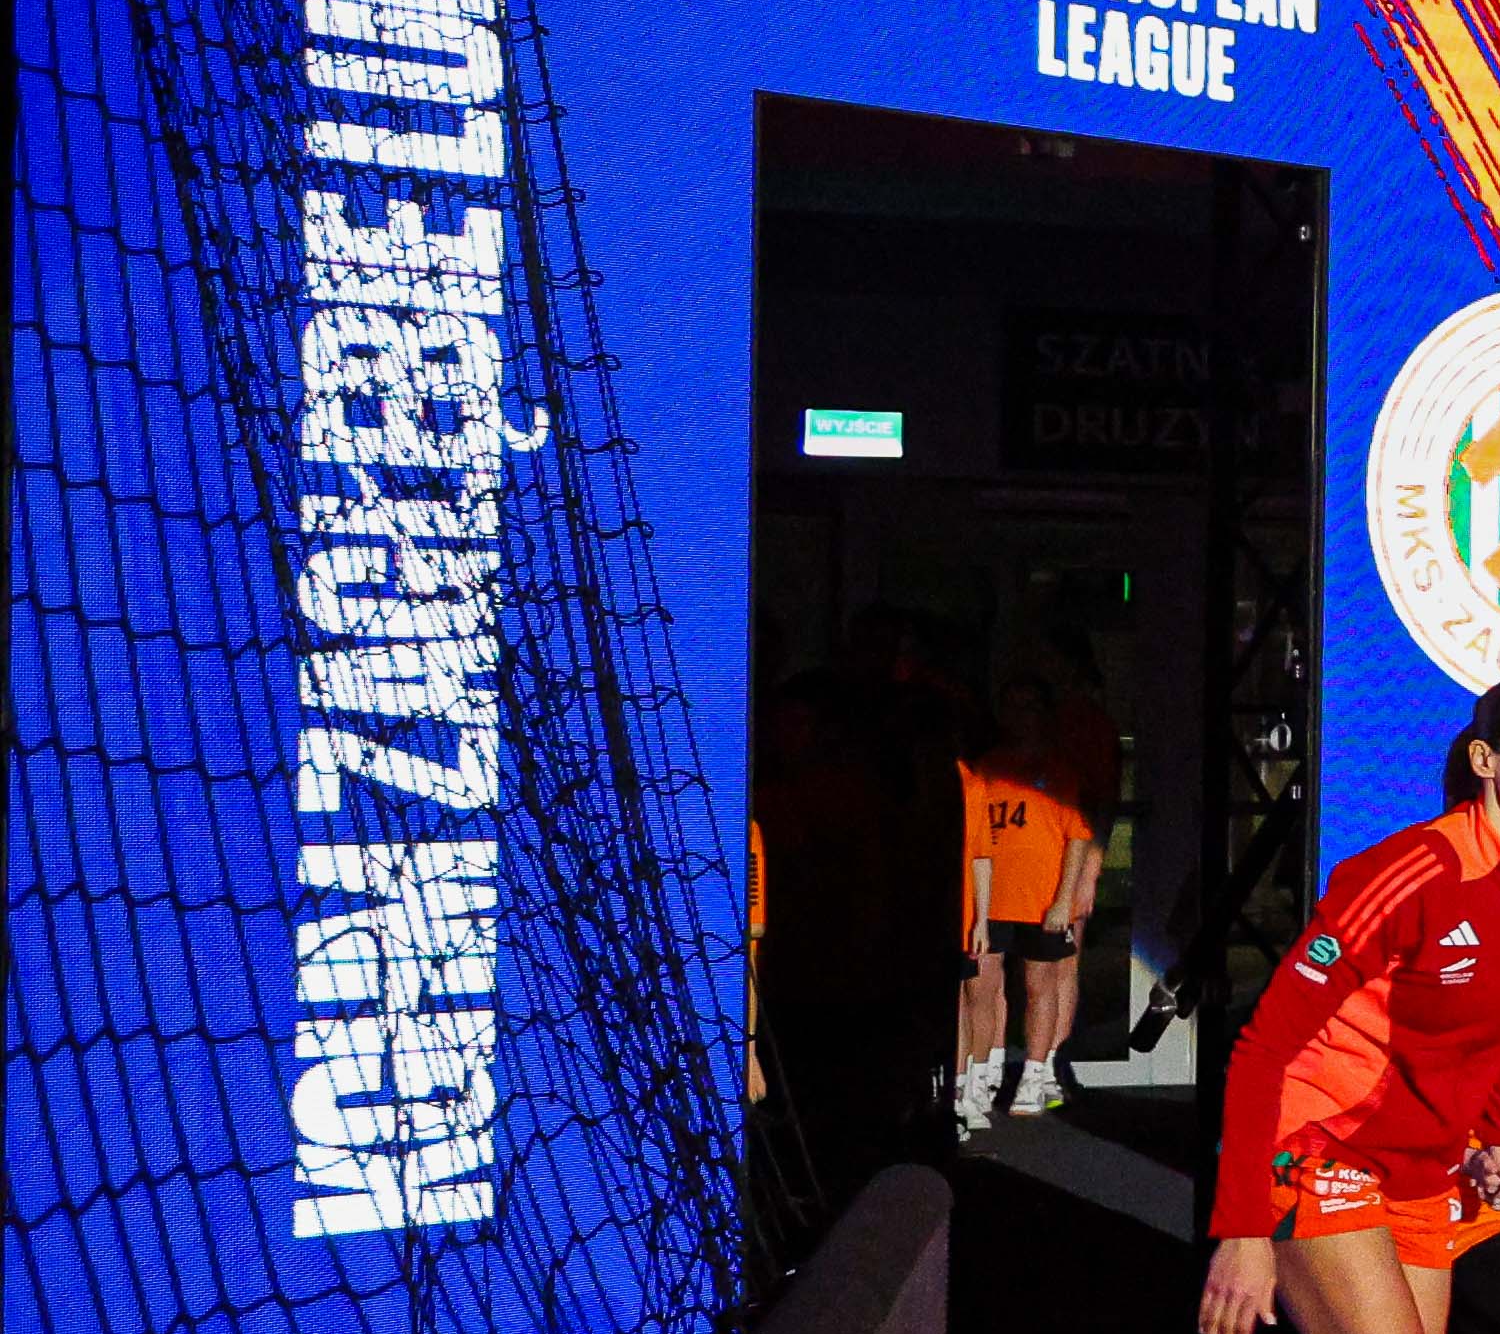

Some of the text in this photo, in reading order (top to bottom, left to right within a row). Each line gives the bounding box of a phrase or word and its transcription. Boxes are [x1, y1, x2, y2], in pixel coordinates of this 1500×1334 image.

[1035, 331, 1213, 380] SZATN
[815, 418, 895, 435] WYJŚCIE
[1395, 483, 1443, 592] MKS
[291, 840, 498, 1238] KGHM
